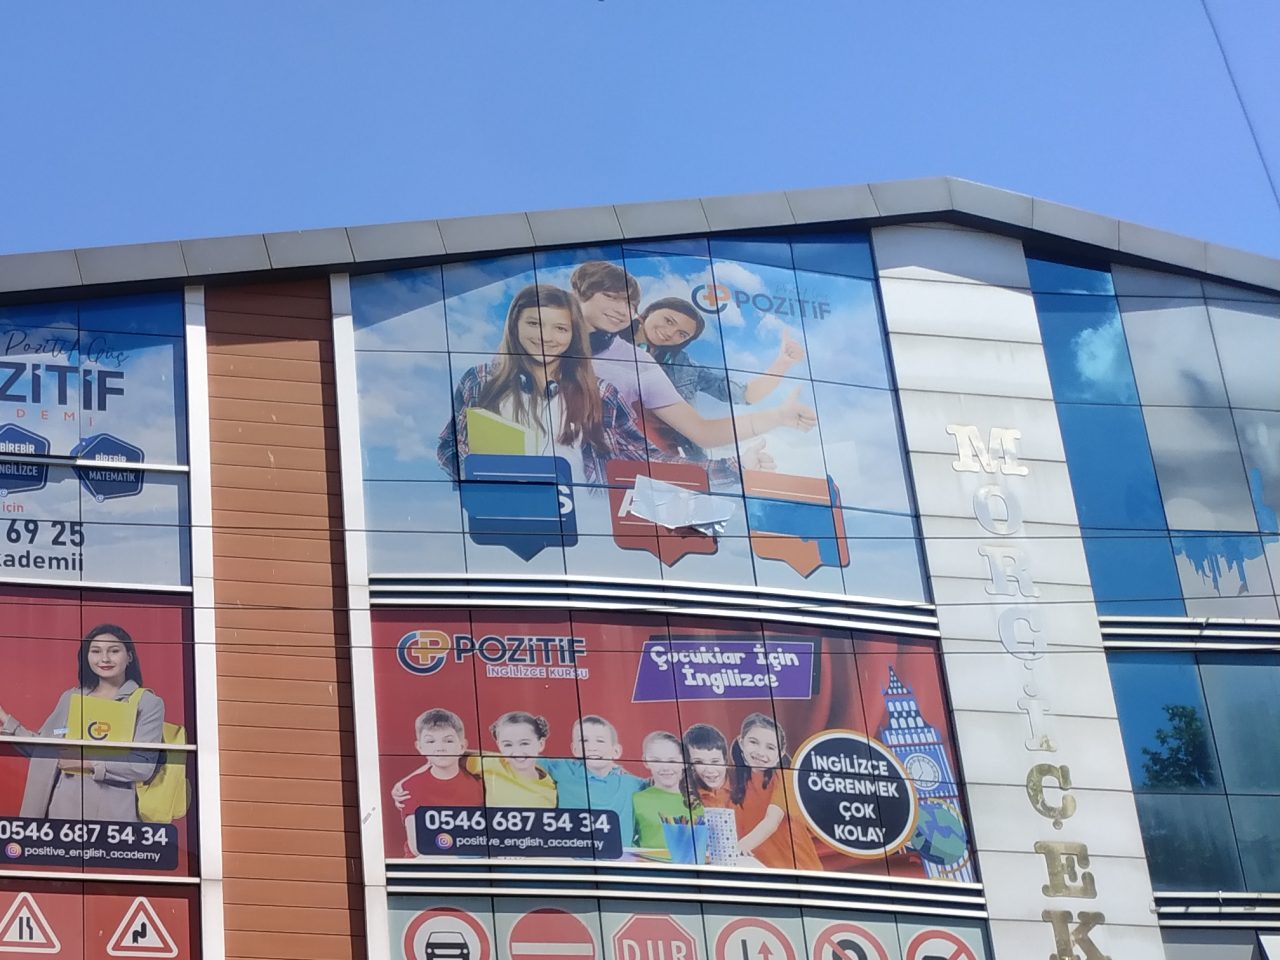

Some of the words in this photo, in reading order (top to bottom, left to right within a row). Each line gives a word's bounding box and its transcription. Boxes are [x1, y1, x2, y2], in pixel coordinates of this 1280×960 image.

[89, 470, 136, 482] MATEMATİK
[2, 502, 24, 513] için
[6, 519, 39, 545] 69
[50, 521, 86, 547] 25
[650, 644, 746, 671] Çocuklar
[753, 642, 800, 671] İçin
[549, 667, 589, 680] KURSU
[682, 665, 780, 694] İngilizce
[810, 750, 889, 776] İNGİLİZCE
[807, 771, 900, 798] ÖĞRENMEK
[425, 809, 486, 831] 0546
[491, 811, 537, 832] 687
[542, 812, 574, 833] 54
[578, 813, 612, 834] 34
[838, 800, 877, 821] ÇOK
[59, 823, 102, 843] 687
[106, 825, 136, 844] 54
[140, 826, 169, 846] 34
[833, 823, 886, 844] KOLAY
